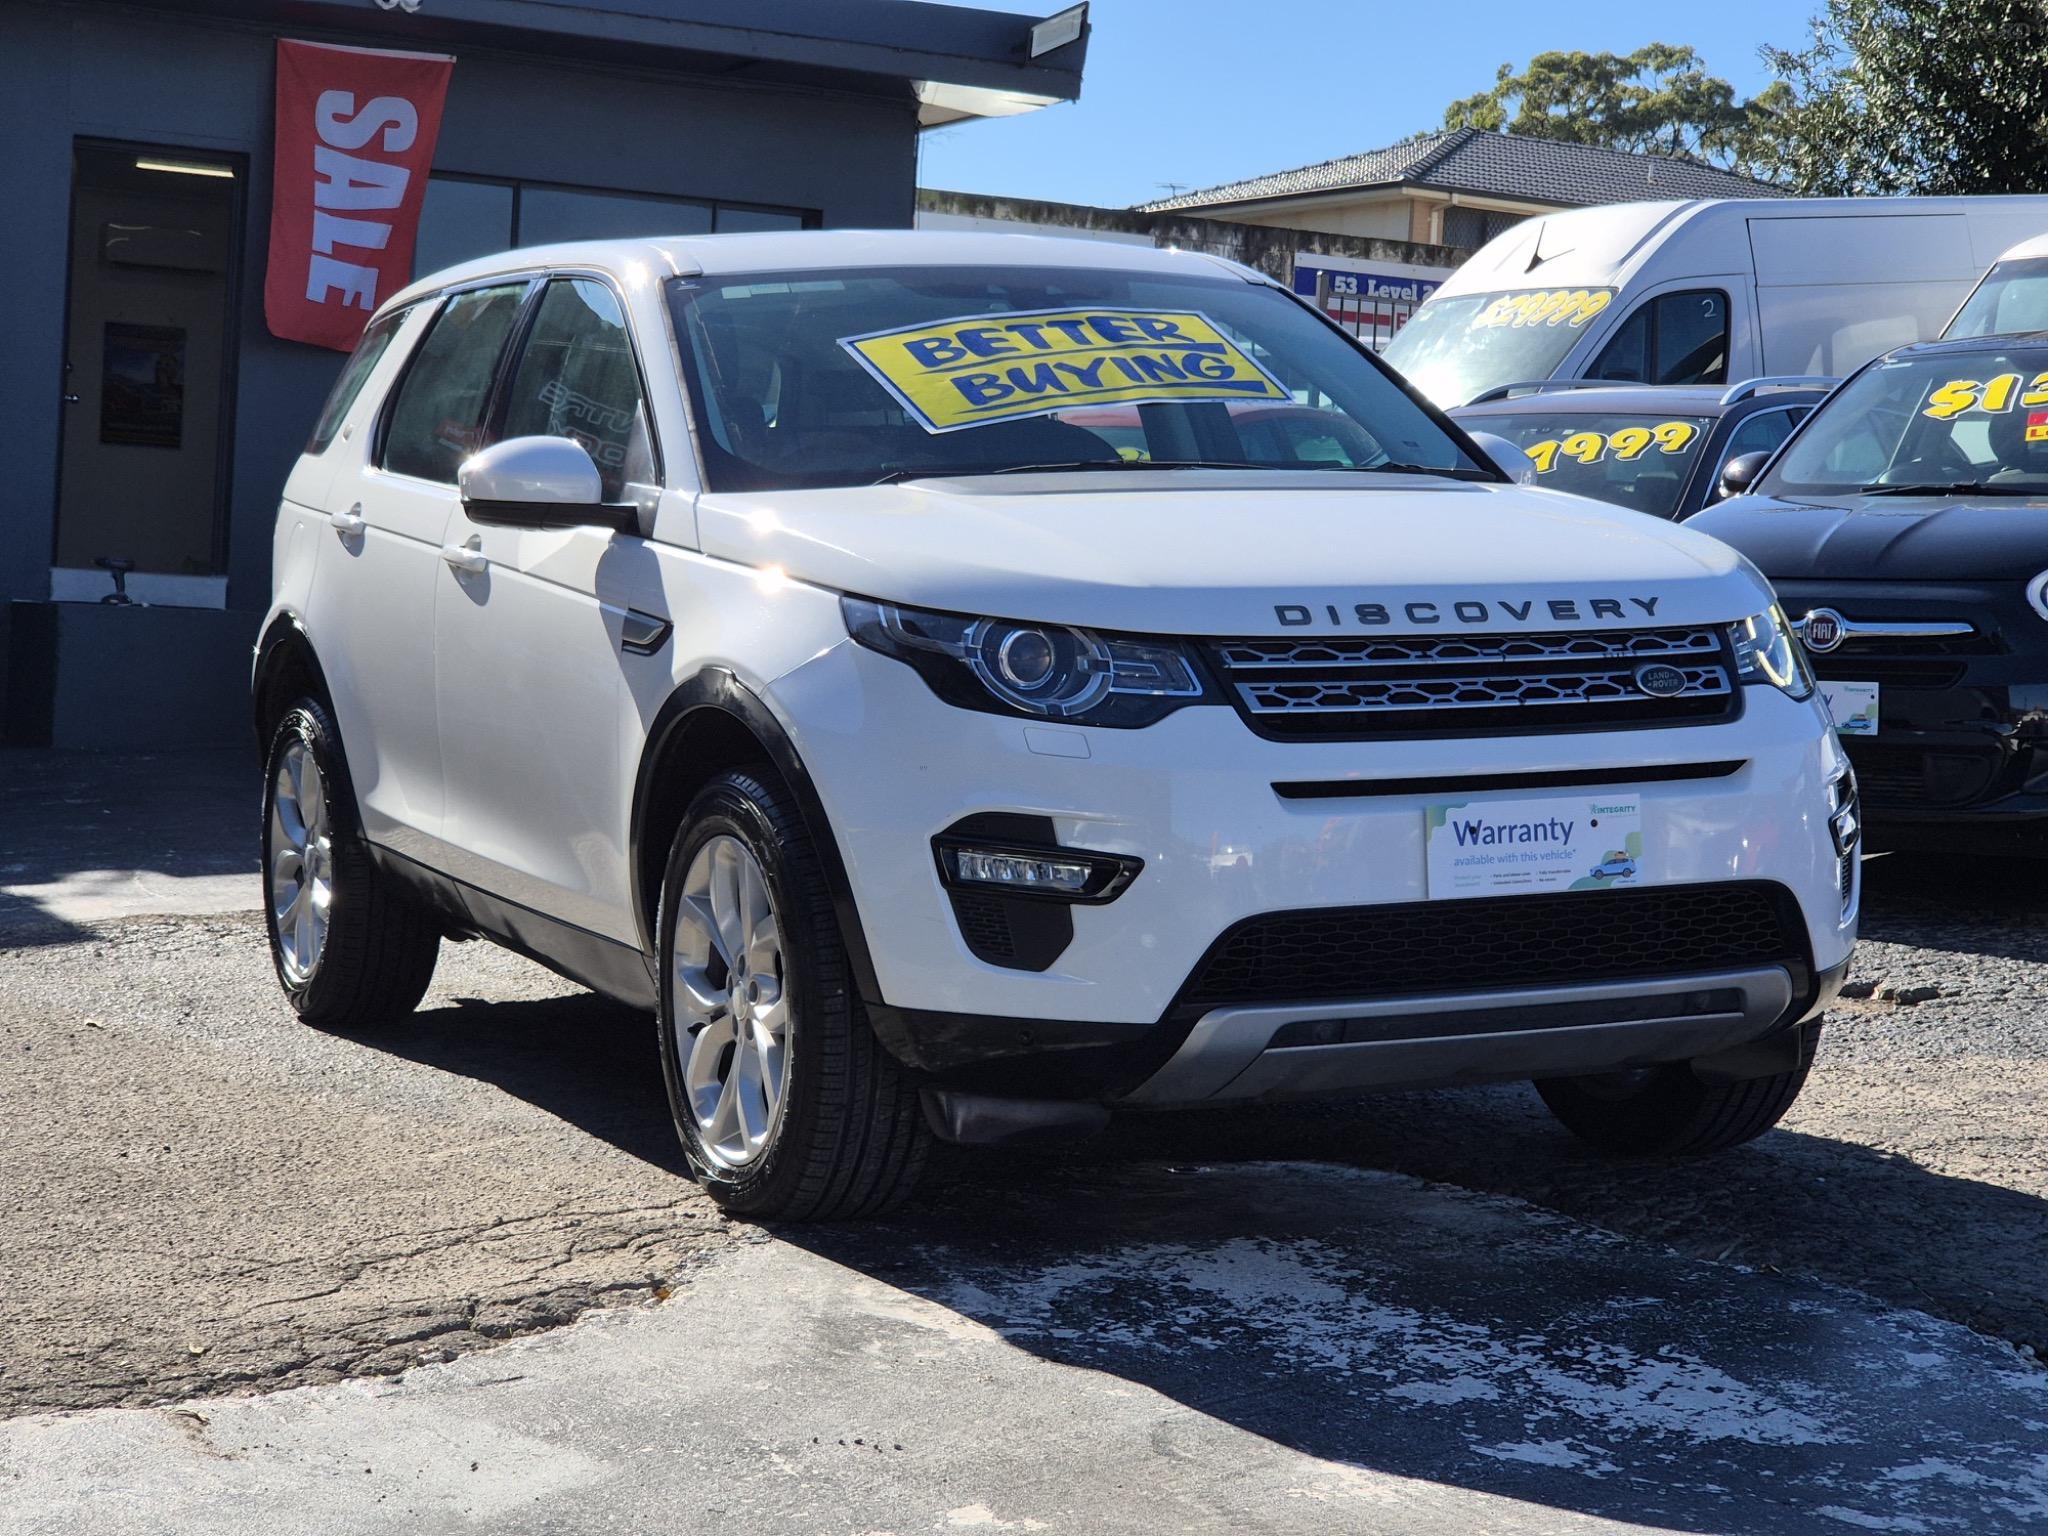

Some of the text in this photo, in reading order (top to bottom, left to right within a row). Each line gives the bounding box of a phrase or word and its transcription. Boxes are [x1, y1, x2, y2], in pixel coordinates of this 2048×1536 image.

[306, 89, 418, 311] SALE
[1334, 275, 1358, 295] 53
[1367, 279, 1418, 300] Level
[1702, 300, 1717, 317] 2
[903, 316, 1195, 368] BETTER
[950, 353, 1236, 406] BUYING
[1274, 597, 1659, 627] DISCOVERY
[1813, 623, 1833, 639] FIAT
[1453, 817, 1574, 846] Warranty
[1454, 852, 1495, 867] available
[1497, 851, 1518, 864] with
[1521, 850, 1538, 863] this
